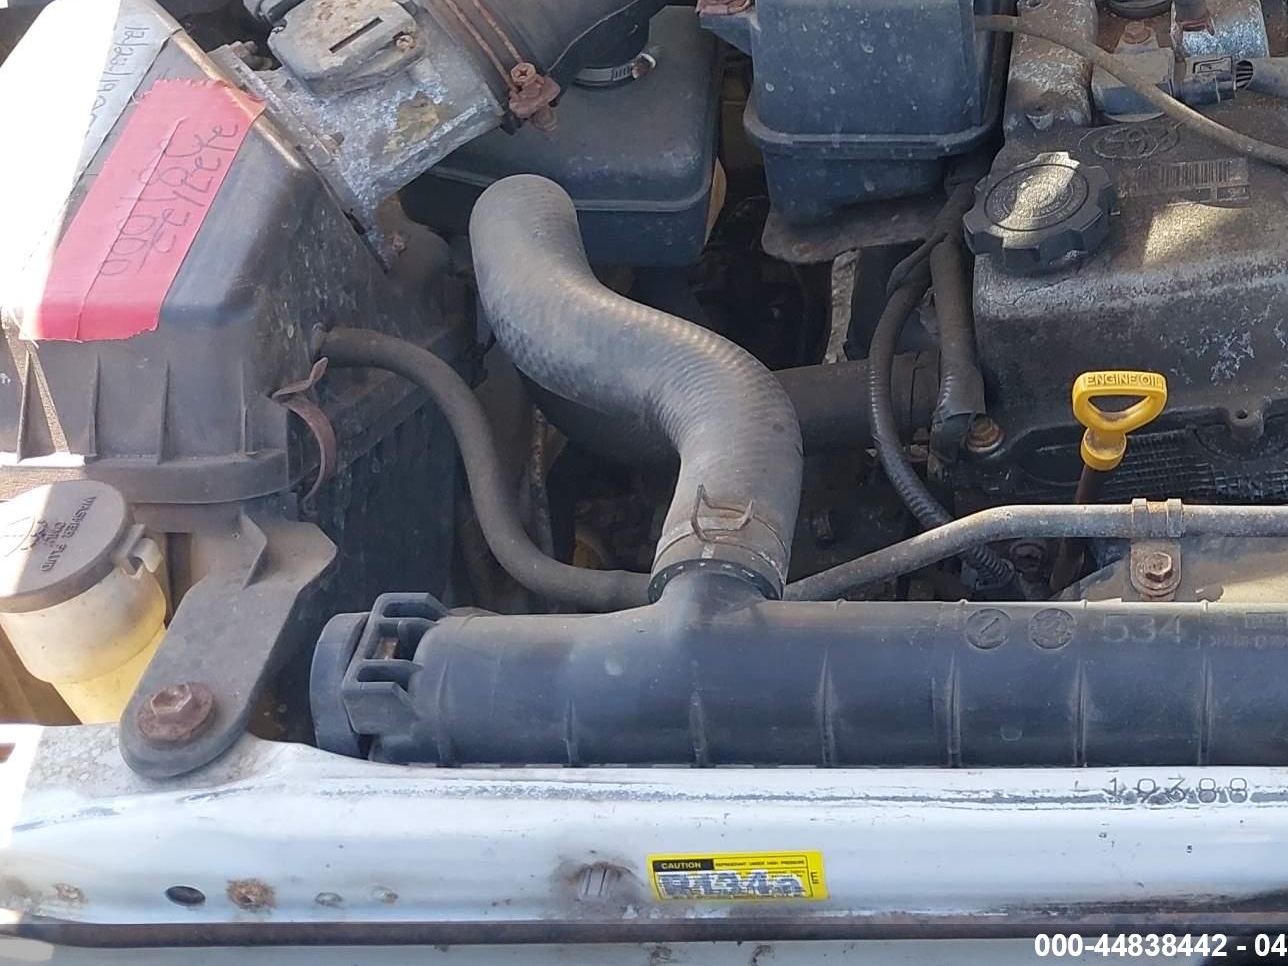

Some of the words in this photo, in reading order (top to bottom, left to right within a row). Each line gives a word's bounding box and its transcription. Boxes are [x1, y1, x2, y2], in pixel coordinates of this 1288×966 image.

[1086, 374, 1138, 386] ENGINE
[1140, 375, 1164, 389] OIL
[660, 862, 702, 870] CAUTION
